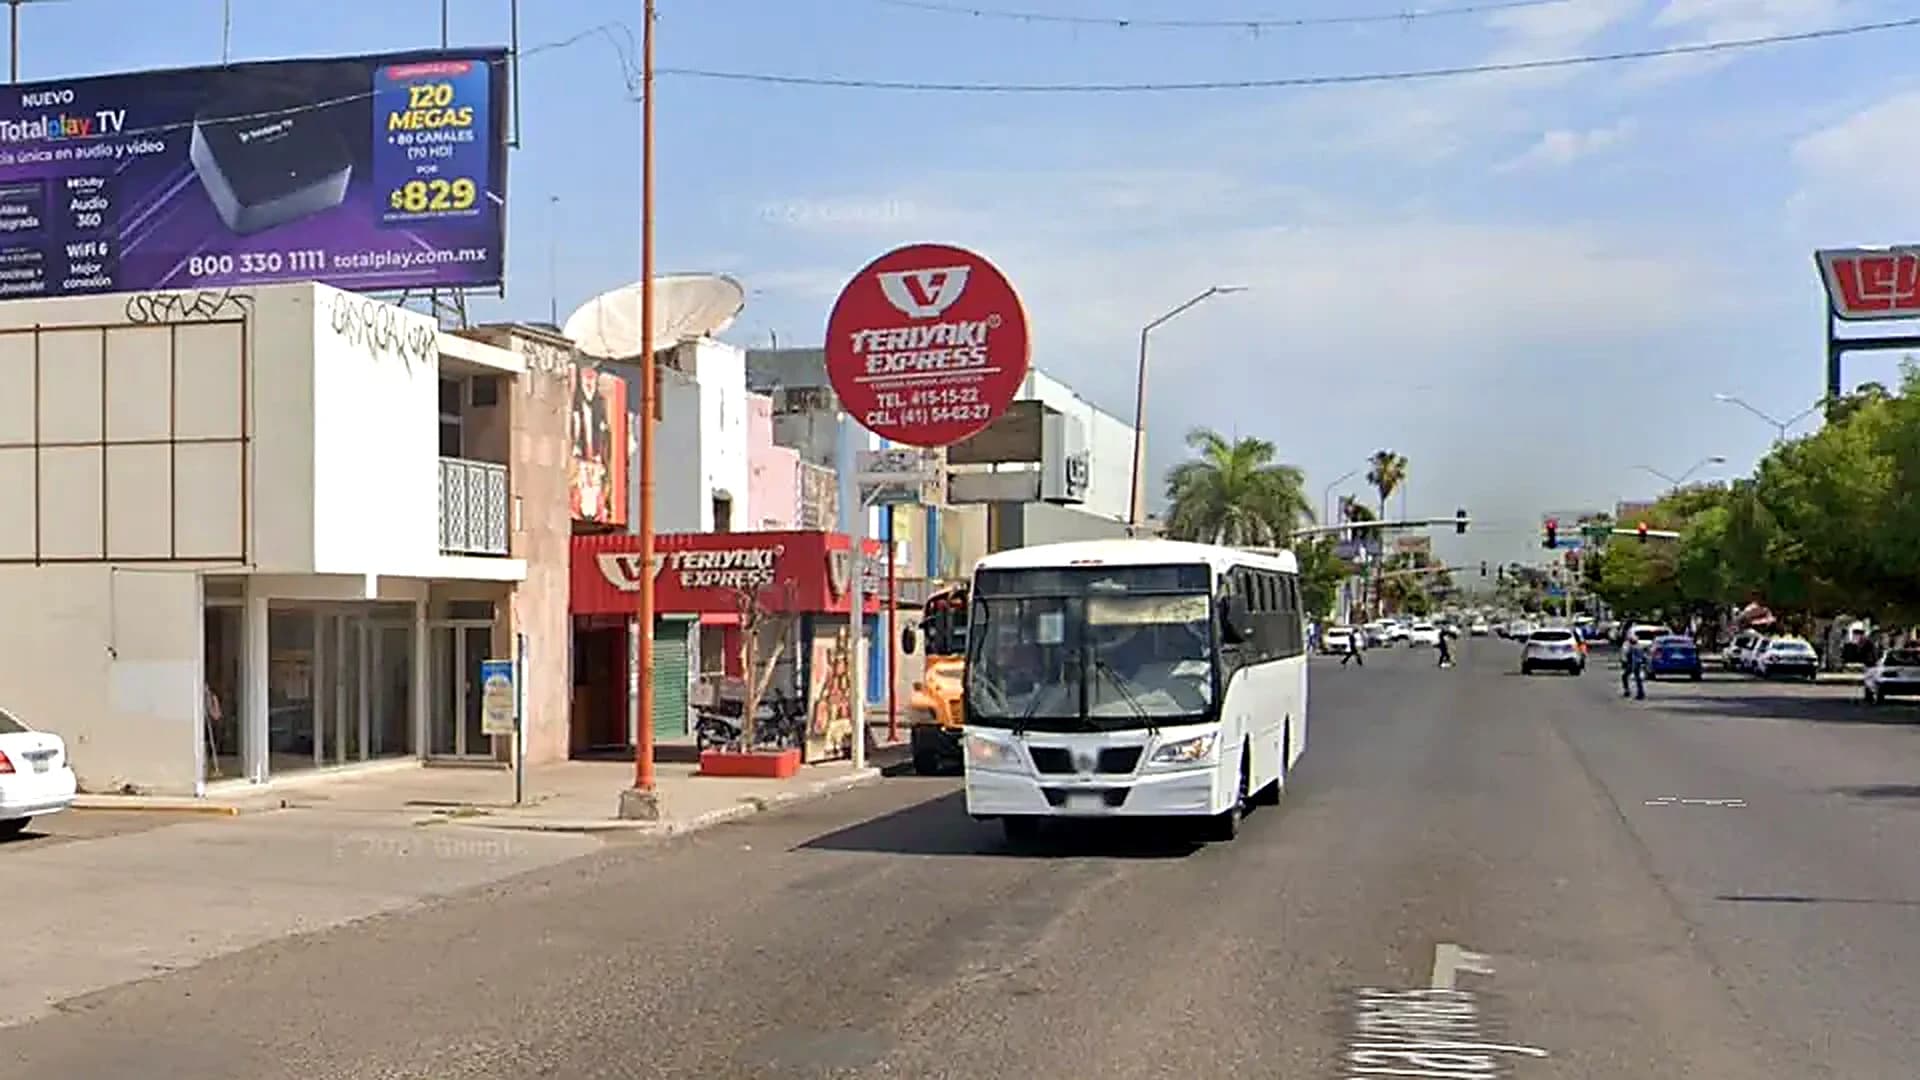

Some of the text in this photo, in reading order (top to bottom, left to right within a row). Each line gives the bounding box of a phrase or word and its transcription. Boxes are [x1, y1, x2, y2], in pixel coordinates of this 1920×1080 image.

[22, 89, 75, 107] NUEVO
[410, 84, 453, 109] 120
[0, 109, 126, 141] Totalplay TV
[388, 107, 474, 131] MEGAS
[397, 134, 413, 146] 80
[415, 130, 474, 144] CANALES
[17, 147, 52, 163] única
[55, 148, 73, 160] en
[75, 143, 113, 159] audio
[115, 144, 125, 159] y
[126, 140, 166, 155] video
[407, 146, 427, 161] (70
[70, 195, 109, 211] Audio
[391, 177, 476, 212] $829
[77, 212, 102, 228] 360
[70, 262, 102, 276] Mejor
[189, 247, 487, 277] 800 330 1111 totalplay.com.mx
[850, 320, 988, 354] TERIYAKI
[865, 346, 988, 375] EXPRESS
[876, 392, 908, 409] TEL.
[866, 411, 898, 426] CEL.
[669, 548, 774, 571] TERIYAKI
[680, 568, 775, 588] EXPRESS
